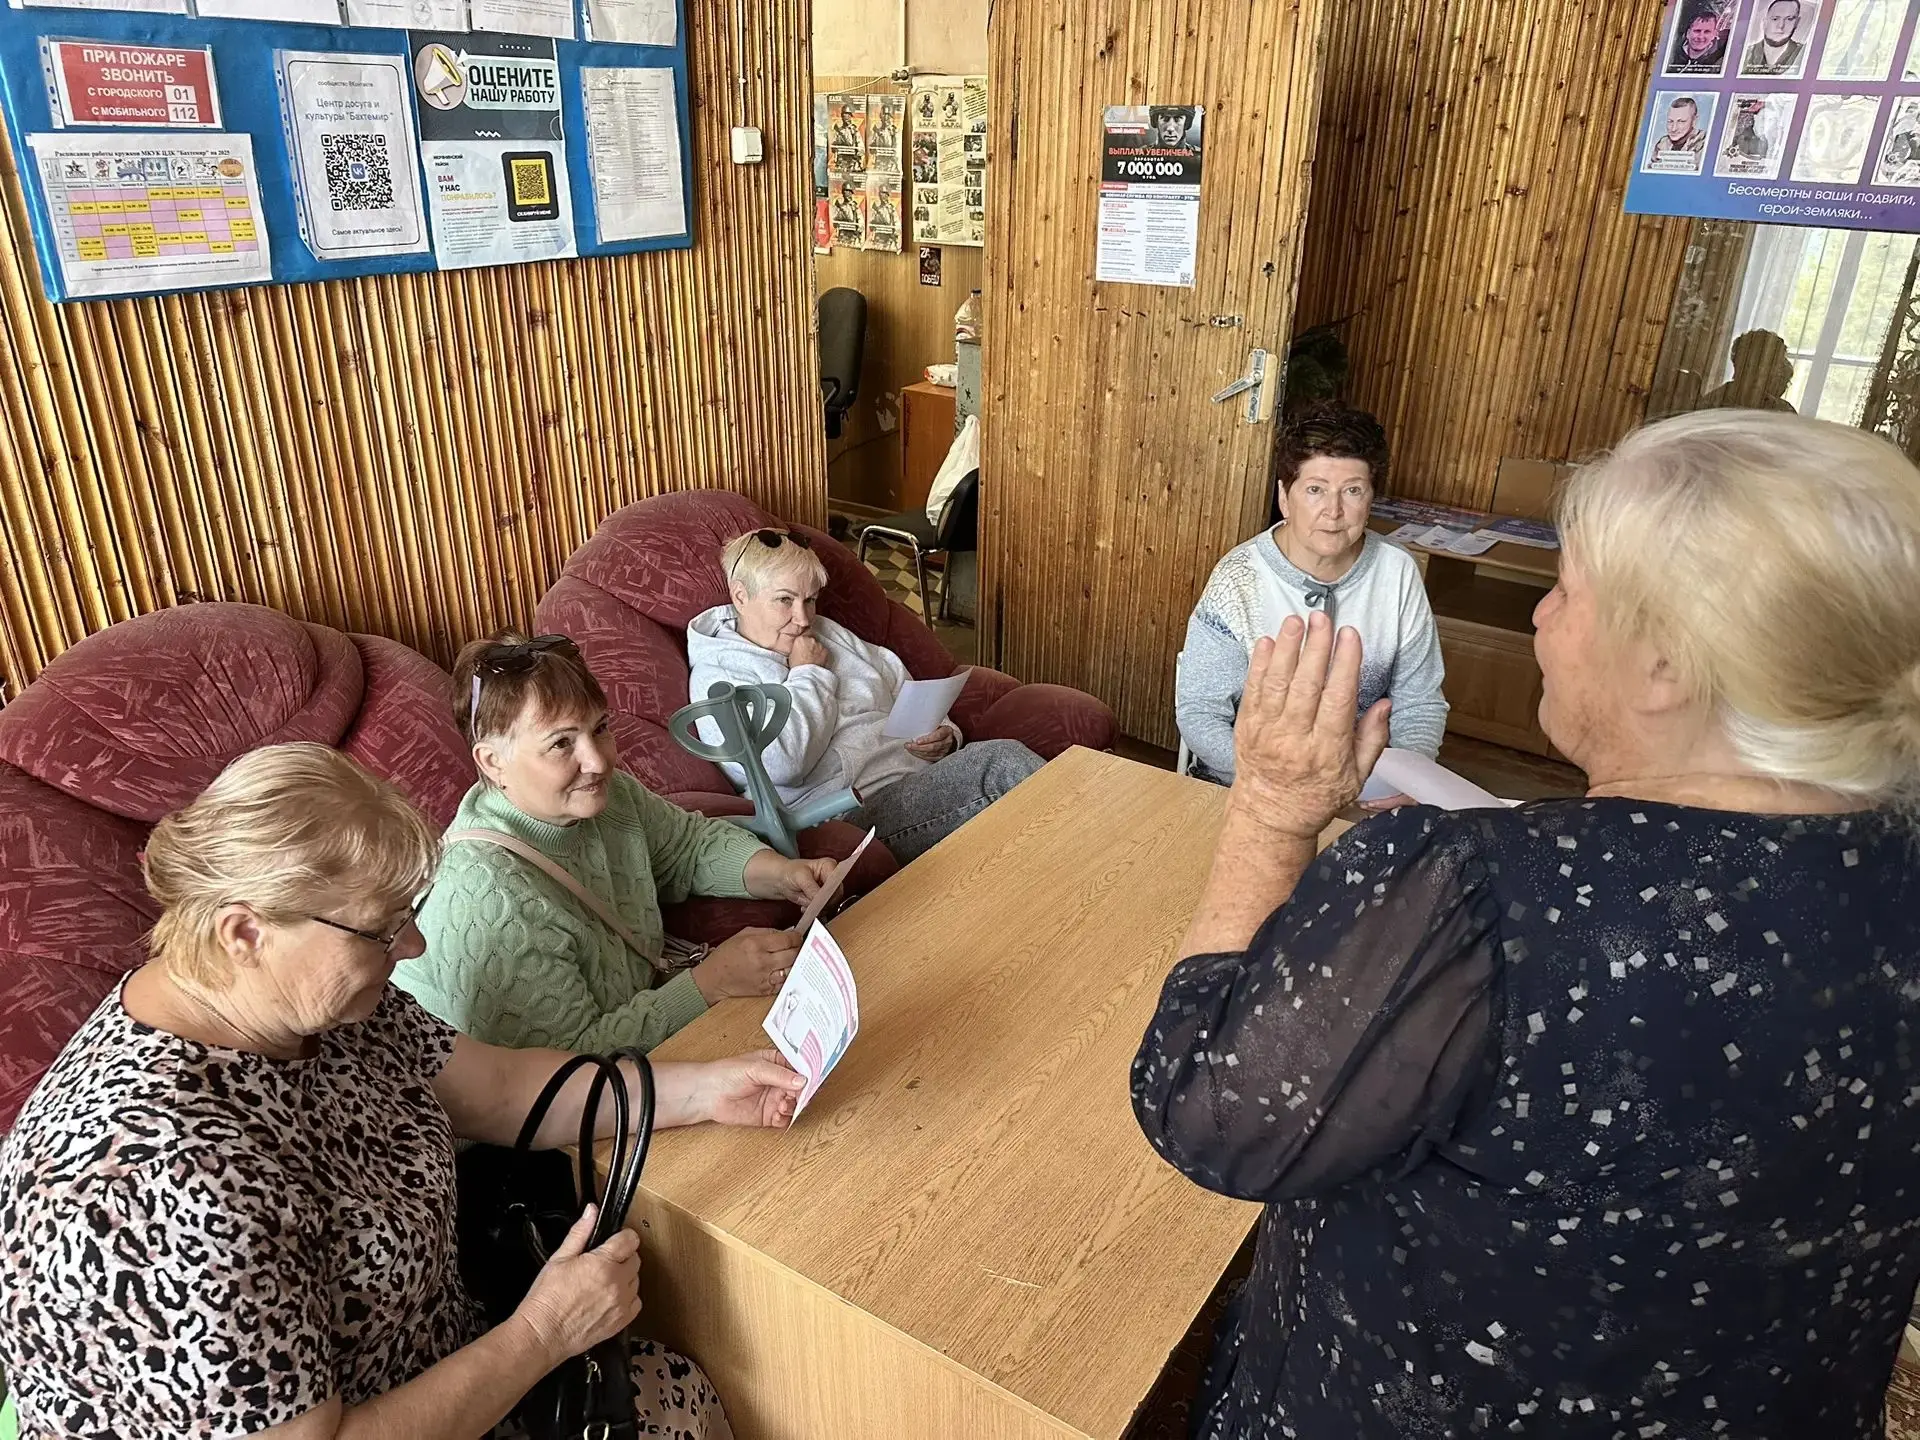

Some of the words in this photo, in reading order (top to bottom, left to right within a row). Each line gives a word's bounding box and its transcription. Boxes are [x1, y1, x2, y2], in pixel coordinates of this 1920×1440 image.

[83, 49, 117, 63] ПРИ
[120, 51, 187, 67] ПОЖАРЕ
[101, 67, 175, 83] ЗВОНИТЬ
[468, 65, 555, 89] ОЦЕНИТЕ
[98, 87, 164, 99] ГОРОДСКОГО
[173, 87, 190, 101] 01
[470, 88, 507, 102] НАШУ
[510, 89, 555, 103] РАБОТУ
[316, 98, 344, 108] Центр
[345, 100, 373, 109] досуга
[101, 106, 167, 117] МОБИЛЬНОГО
[172, 107, 197, 120] 112
[305, 113, 345, 122] культуры
[1108, 147, 1145, 156] ВЫПЛАТА
[1146, 148, 1194, 157] УВЕЛИЧЕНА
[1117, 161, 1126, 174] 7
[1127, 162, 1153, 175] 000
[1155, 162, 1183, 176] 000
[439, 184, 444, 192] У
[1727, 182, 1812, 200] Бессмертны
[1815, 189, 1853, 201] ваши
[1855, 191, 1916, 206] подвиги,
[441, 192, 497, 201] ПОНРАВИЛОСЬ?
[1758, 202, 1873, 219] герои-земляки...
[331, 228, 352, 236] Самое
[352, 227, 385, 235] актуальное
